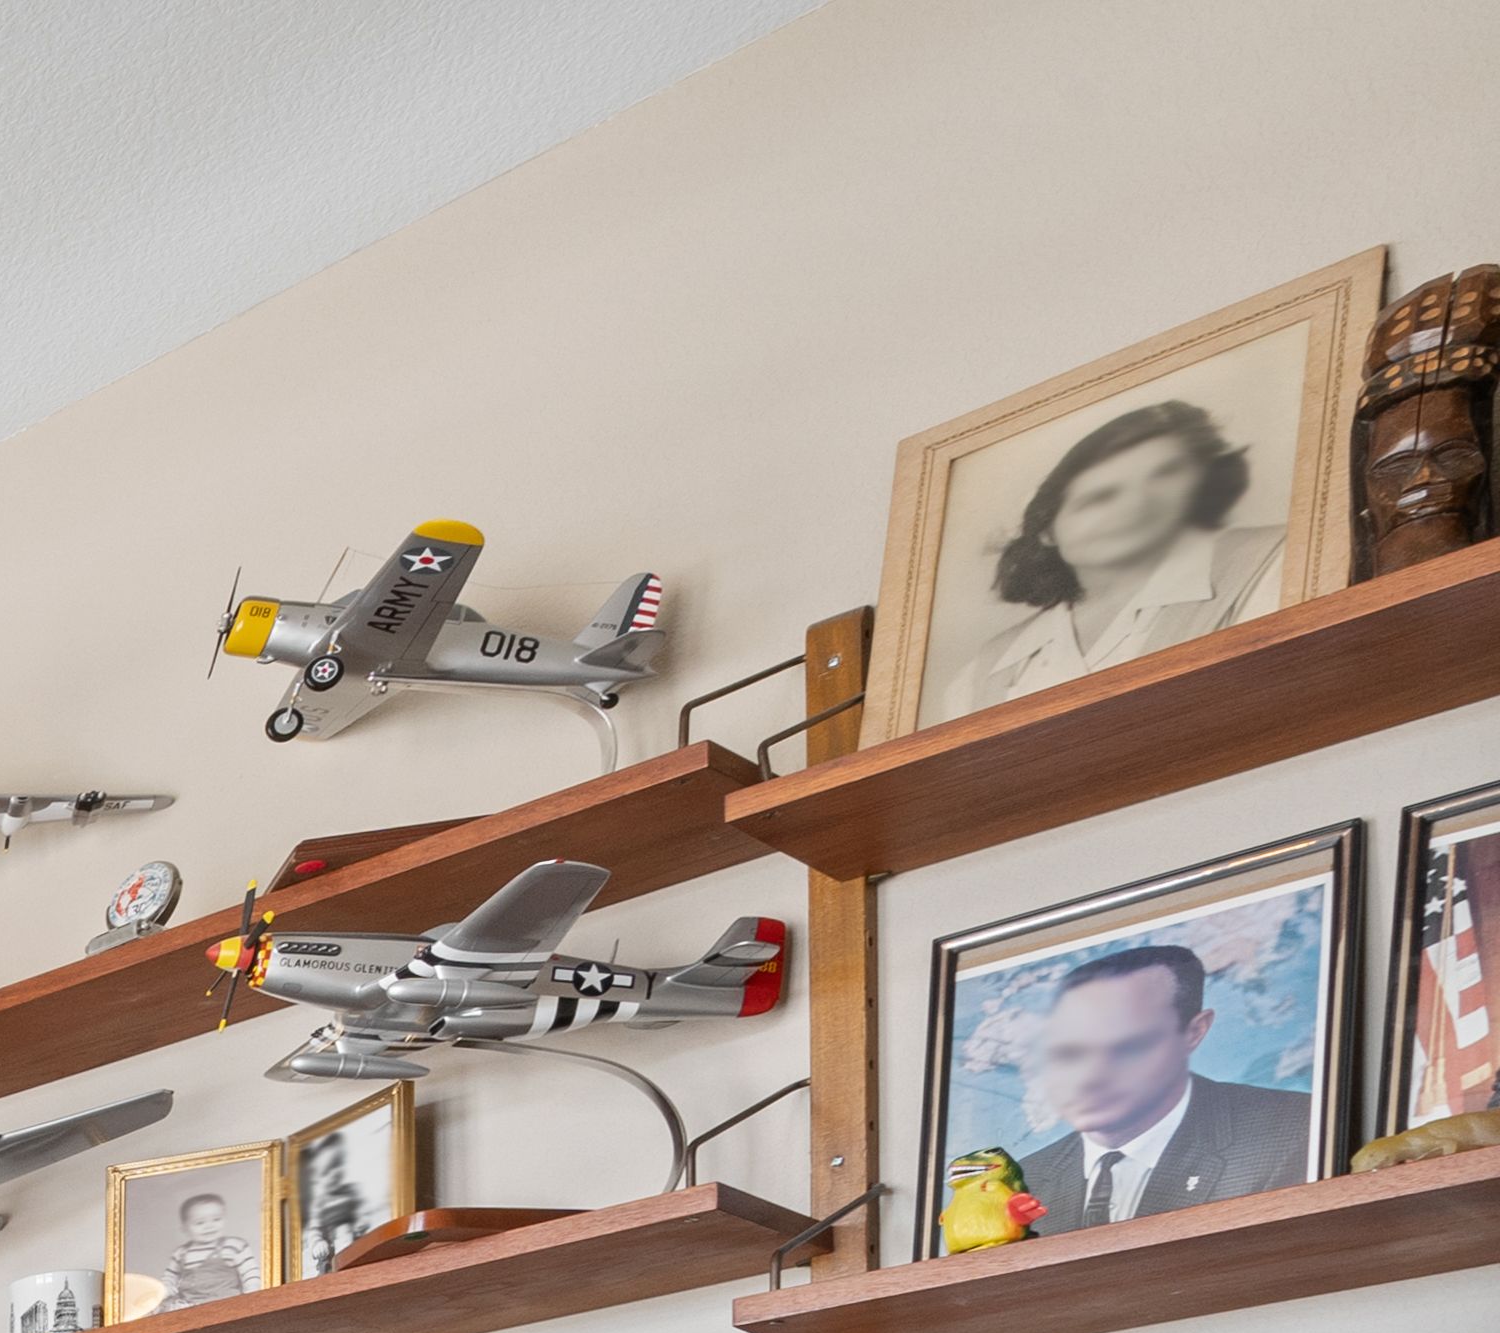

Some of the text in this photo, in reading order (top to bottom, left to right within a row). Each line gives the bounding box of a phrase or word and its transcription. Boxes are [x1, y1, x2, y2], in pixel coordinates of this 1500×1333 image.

[250, 605, 271, 618] 018
[367, 576, 429, 634] ARMY
[480, 630, 540, 663] 018
[103, 800, 132, 811] SAF
[280, 957, 351, 972] GLAMOROUS
[644, 970, 658, 1000] Y
